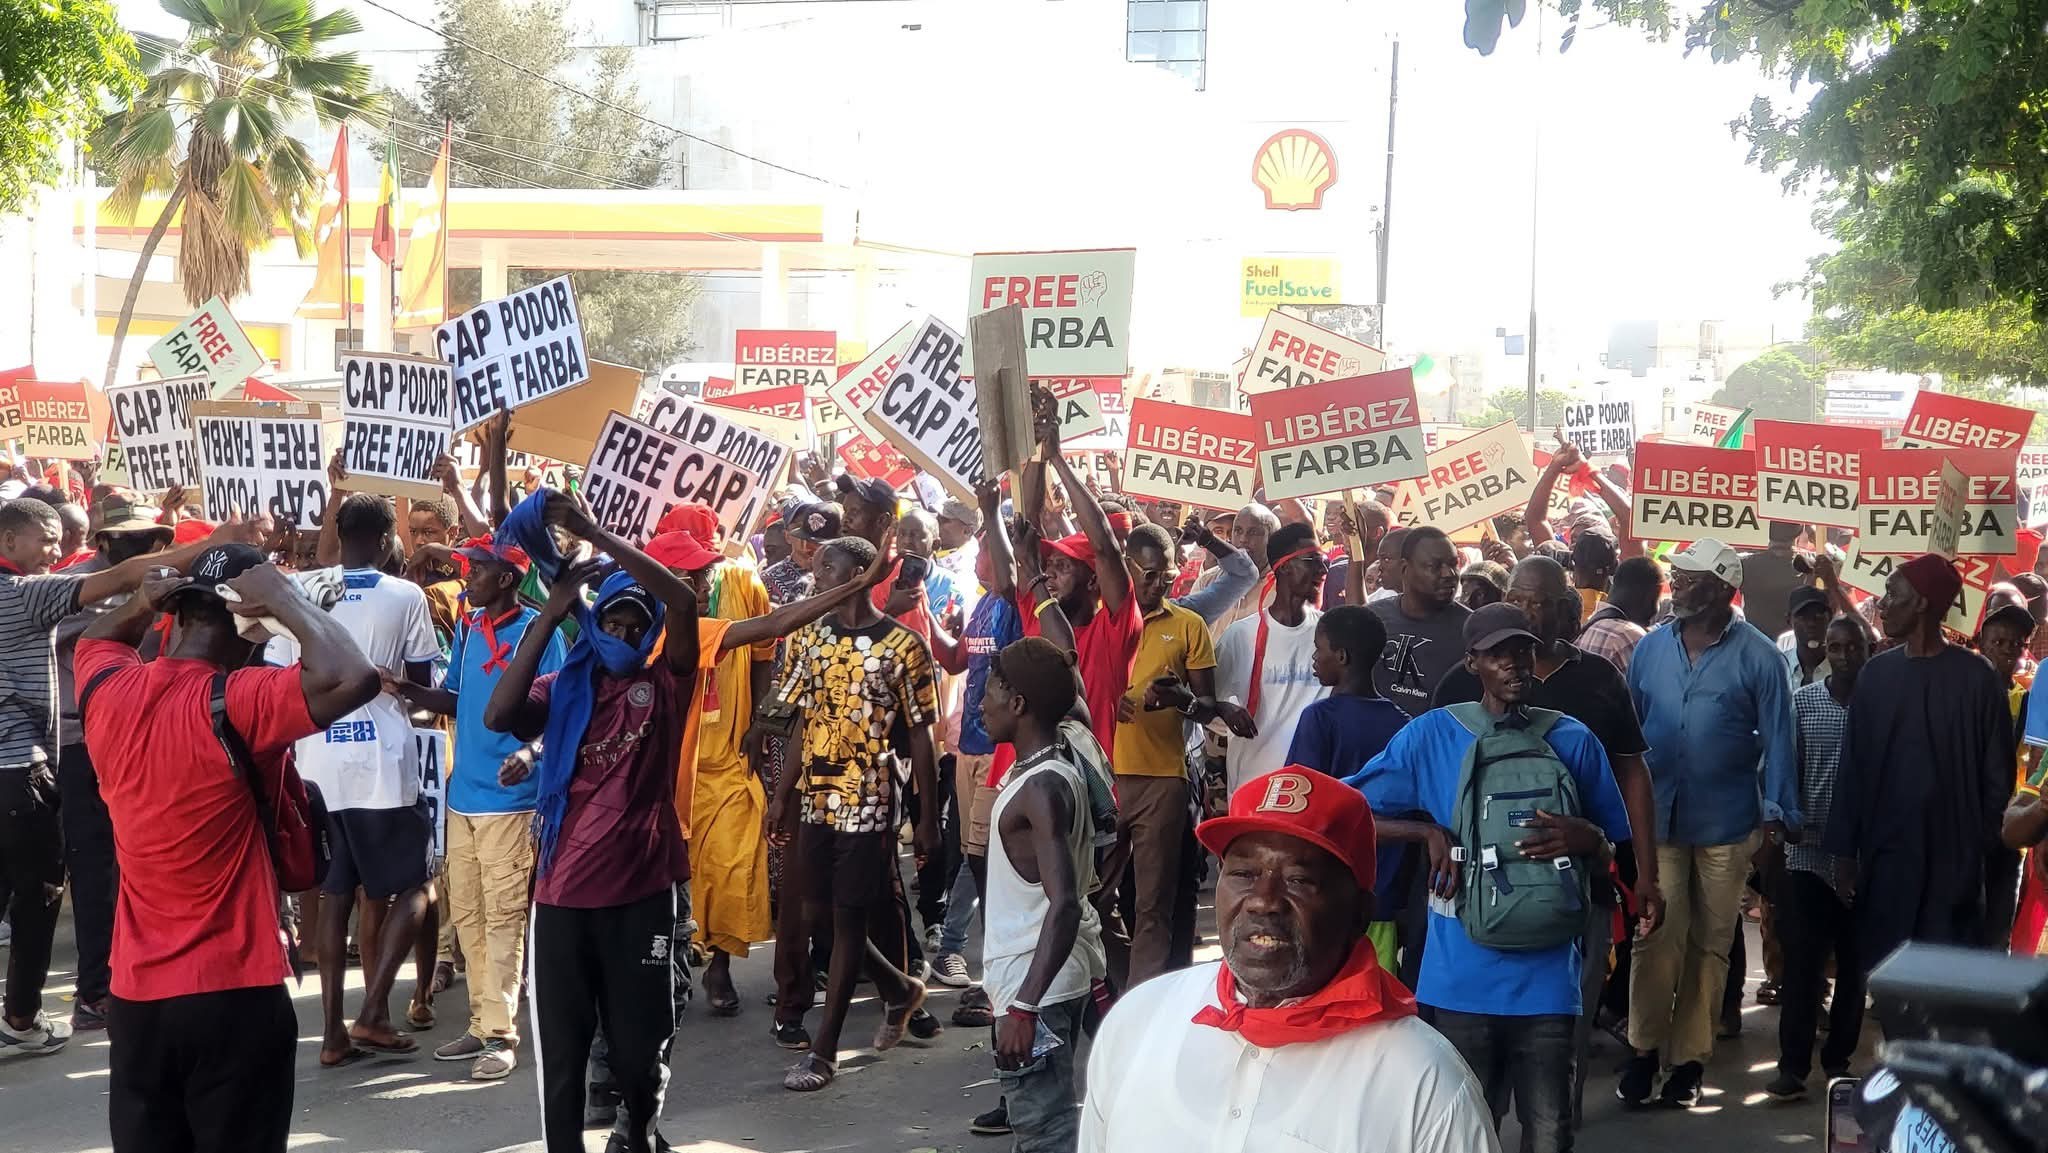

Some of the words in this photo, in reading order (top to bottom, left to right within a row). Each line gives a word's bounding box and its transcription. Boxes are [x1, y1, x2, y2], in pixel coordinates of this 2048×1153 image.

[982, 274, 1080, 311] FREE
[1245, 280, 1333, 298] FuelSave
[1246, 265, 1279, 278] Shell
[189, 311, 233, 365] FREE
[436, 309, 492, 368] CAP
[499, 281, 574, 346] PODOR
[1025, 316, 1114, 349] RBA
[742, 343, 835, 364] LIBÉREZ
[1268, 329, 1341, 376] FREE
[345, 359, 394, 410] CAP
[398, 364, 448, 418] PODOR
[454, 362, 507, 424] REE
[510, 335, 584, 401] FARBA
[742, 368, 829, 387] FARBA
[844, 354, 902, 409] FREE
[23, 395, 88, 420] LIBÉREZ
[115, 388, 162, 437] CAP
[649, 396, 716, 445] CAP
[881, 372, 952, 441] CAP
[1264, 397, 1414, 447] LIBÉREZ
[1565, 404, 1594, 427] CAP
[1599, 402, 1630, 425] PODOR
[1695, 411, 1728, 427] FREE
[26, 424, 87, 447] FARBA
[199, 419, 255, 468] FARBA
[260, 422, 322, 471] FREE
[343, 421, 393, 473] FREE
[1136, 423, 1256, 464] LIBÉREZ
[1568, 430, 1597, 452] FREE
[1601, 428, 1632, 451] FARBA
[1908, 413, 2021, 450] LIBÉREZ
[126, 442, 175, 490] FREE
[596, 420, 677, 490] FREE
[673, 453, 749, 514] CAP
[1132, 454, 1243, 496] FARBA
[1270, 434, 1413, 483] FARBA
[1416, 450, 1488, 497] FREE
[1764, 446, 1859, 477] LIBÉRE
[585, 473, 653, 541] FARBA
[1423, 467, 1527, 521] FARBA
[1868, 470, 2011, 500] LIBÉEZ
[1641, 498, 1760, 531] FARBA
[1391, 683, 1412, 696] Calvin
[1411, 688, 1428, 699] Klein
[1256, 773, 1312, 813] B
